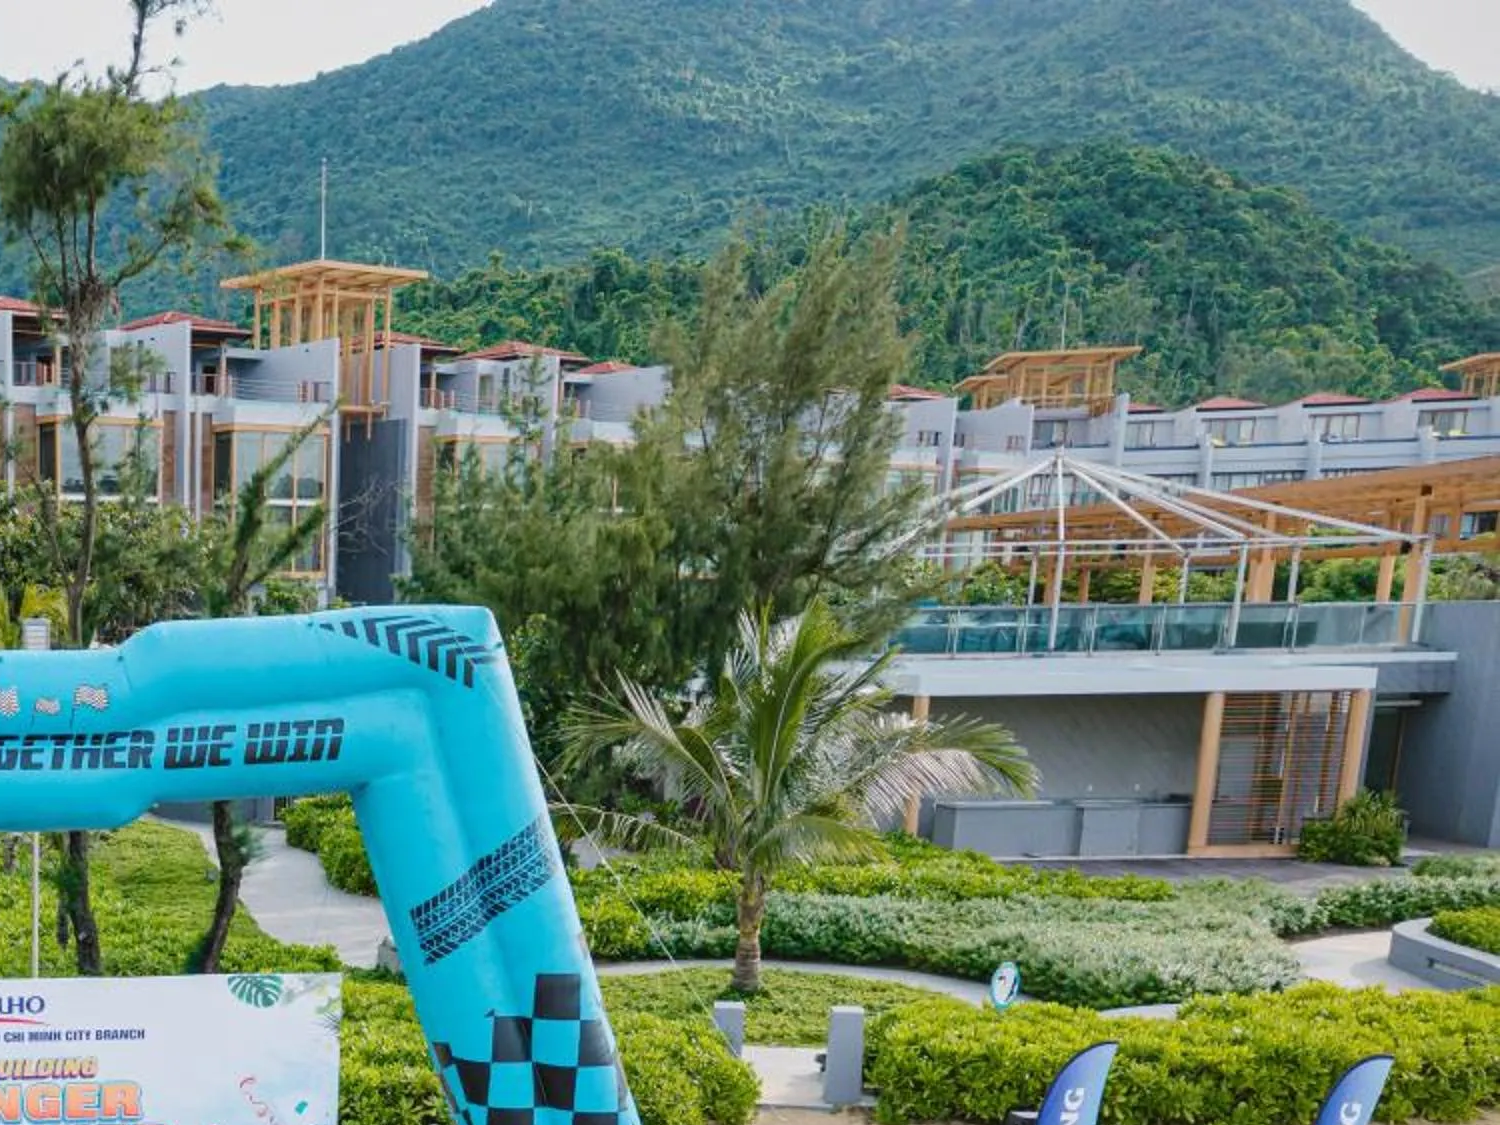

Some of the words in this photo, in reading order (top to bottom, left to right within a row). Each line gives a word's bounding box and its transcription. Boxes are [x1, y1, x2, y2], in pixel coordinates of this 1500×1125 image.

[163, 724, 237, 770] WE
[243, 717, 345, 765] WIN
[2, 1030, 25, 1043] CHI
[27, 1030, 62, 1042] MINH
[64, 1028, 92, 1041] CITY
[94, 1028, 146, 1041] BRANCH
